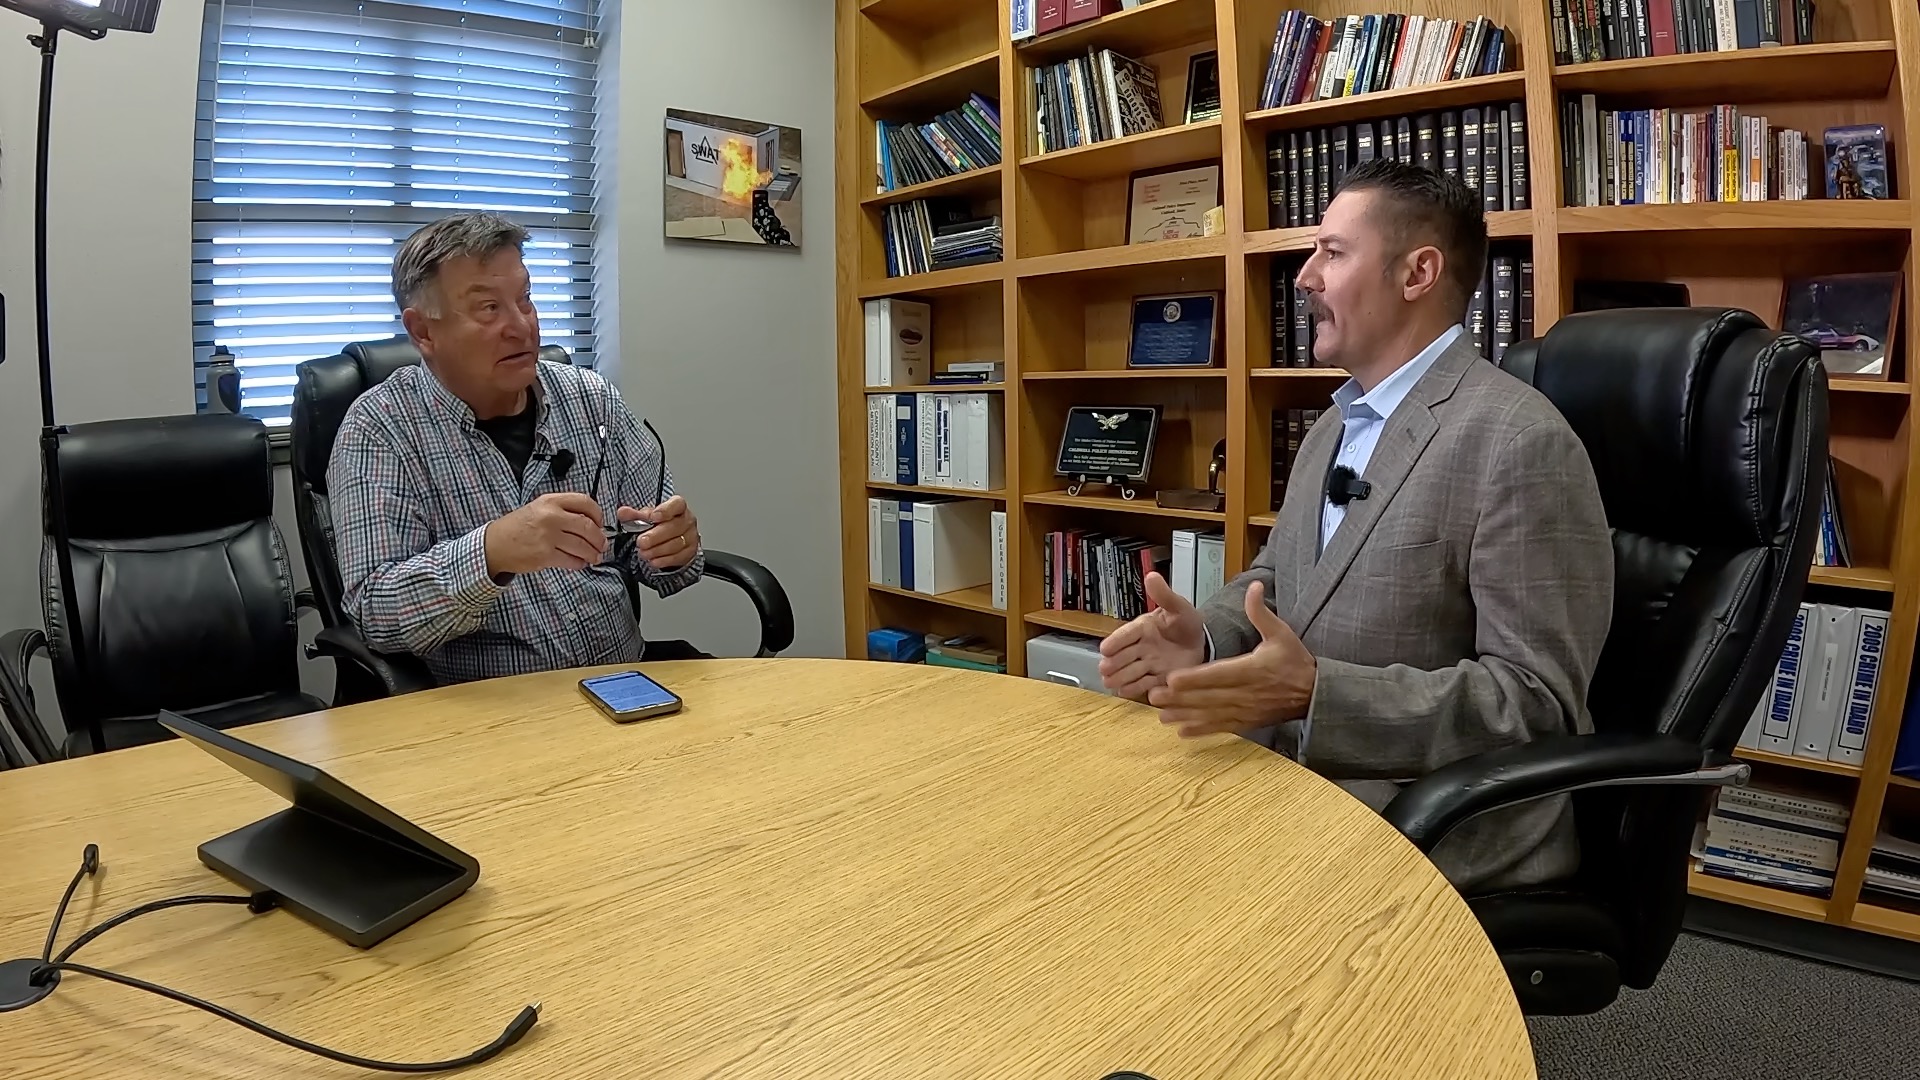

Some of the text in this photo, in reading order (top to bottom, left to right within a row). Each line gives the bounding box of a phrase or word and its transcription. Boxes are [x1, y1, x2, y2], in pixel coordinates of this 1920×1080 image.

[691, 144, 721, 161] SWAT
[1778, 640, 1800, 677] CRIME
[1776, 677, 1795, 690] IN
[1846, 623, 1883, 736] 2009 CRIME IN IDAHO
[1770, 689, 1793, 722] IDAHO
[1729, 844, 1759, 855] CRIME
[1782, 855, 1812, 866] IDAHO
